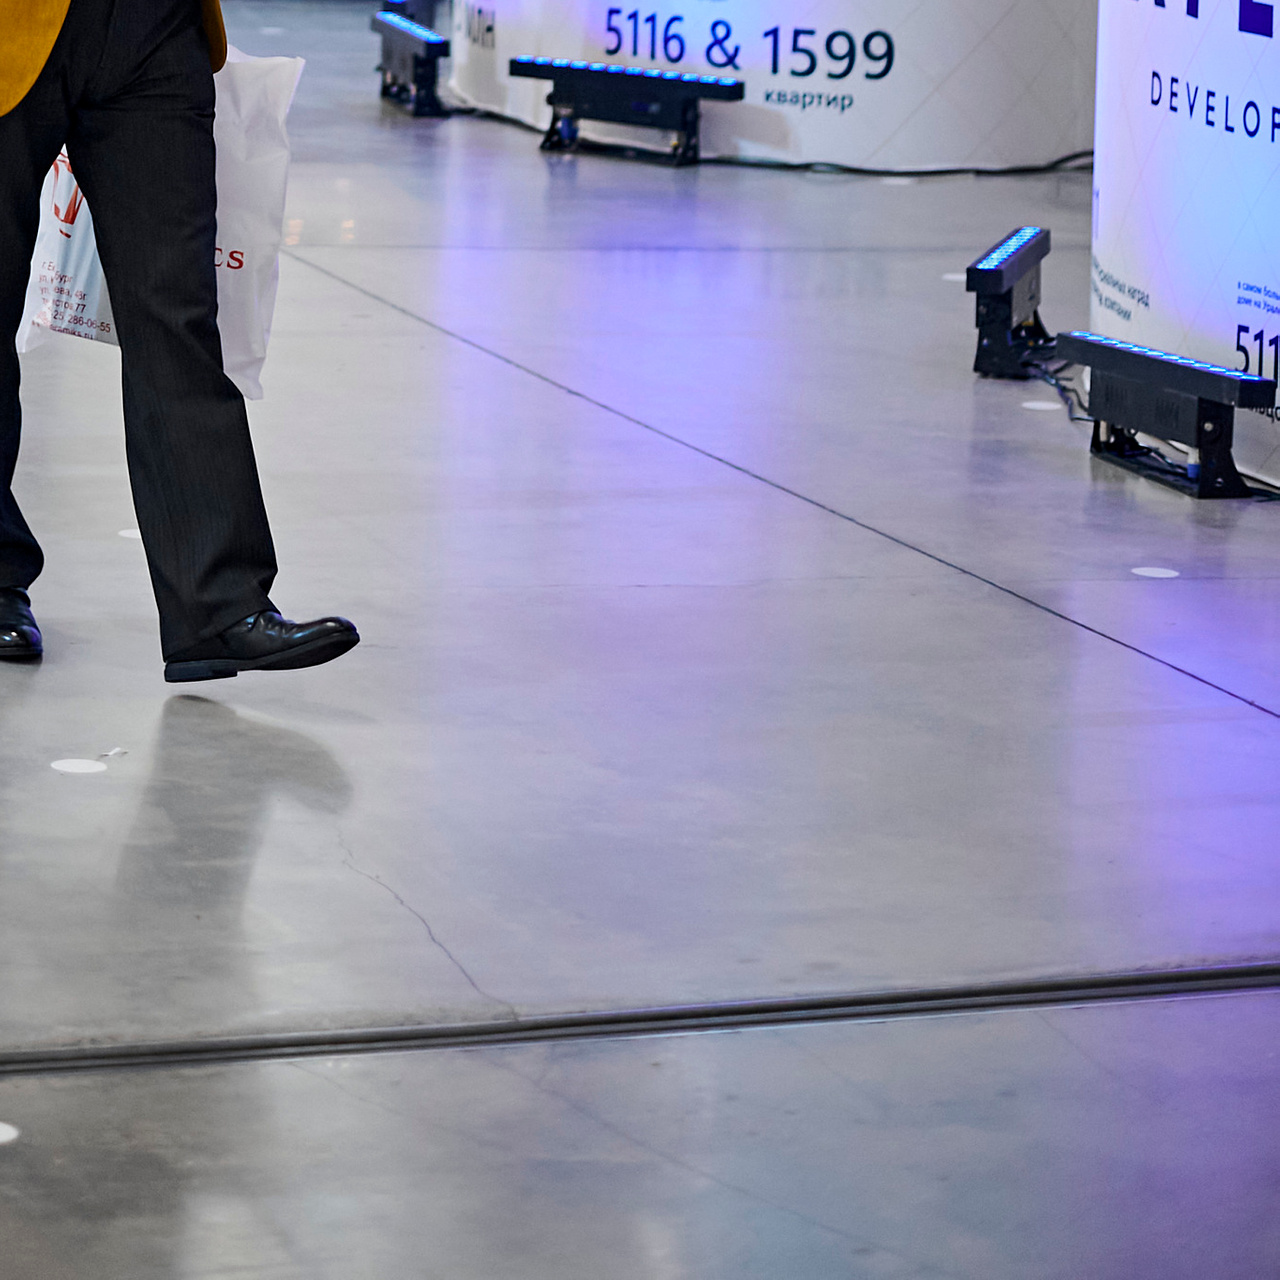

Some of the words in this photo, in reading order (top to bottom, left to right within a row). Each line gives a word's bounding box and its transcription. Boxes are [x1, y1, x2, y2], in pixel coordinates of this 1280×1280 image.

[605, 8, 686, 64] 5116
[705, 19, 741, 70] &
[763, 26, 895, 80] 1599
[764, 90, 854, 112] квартир
